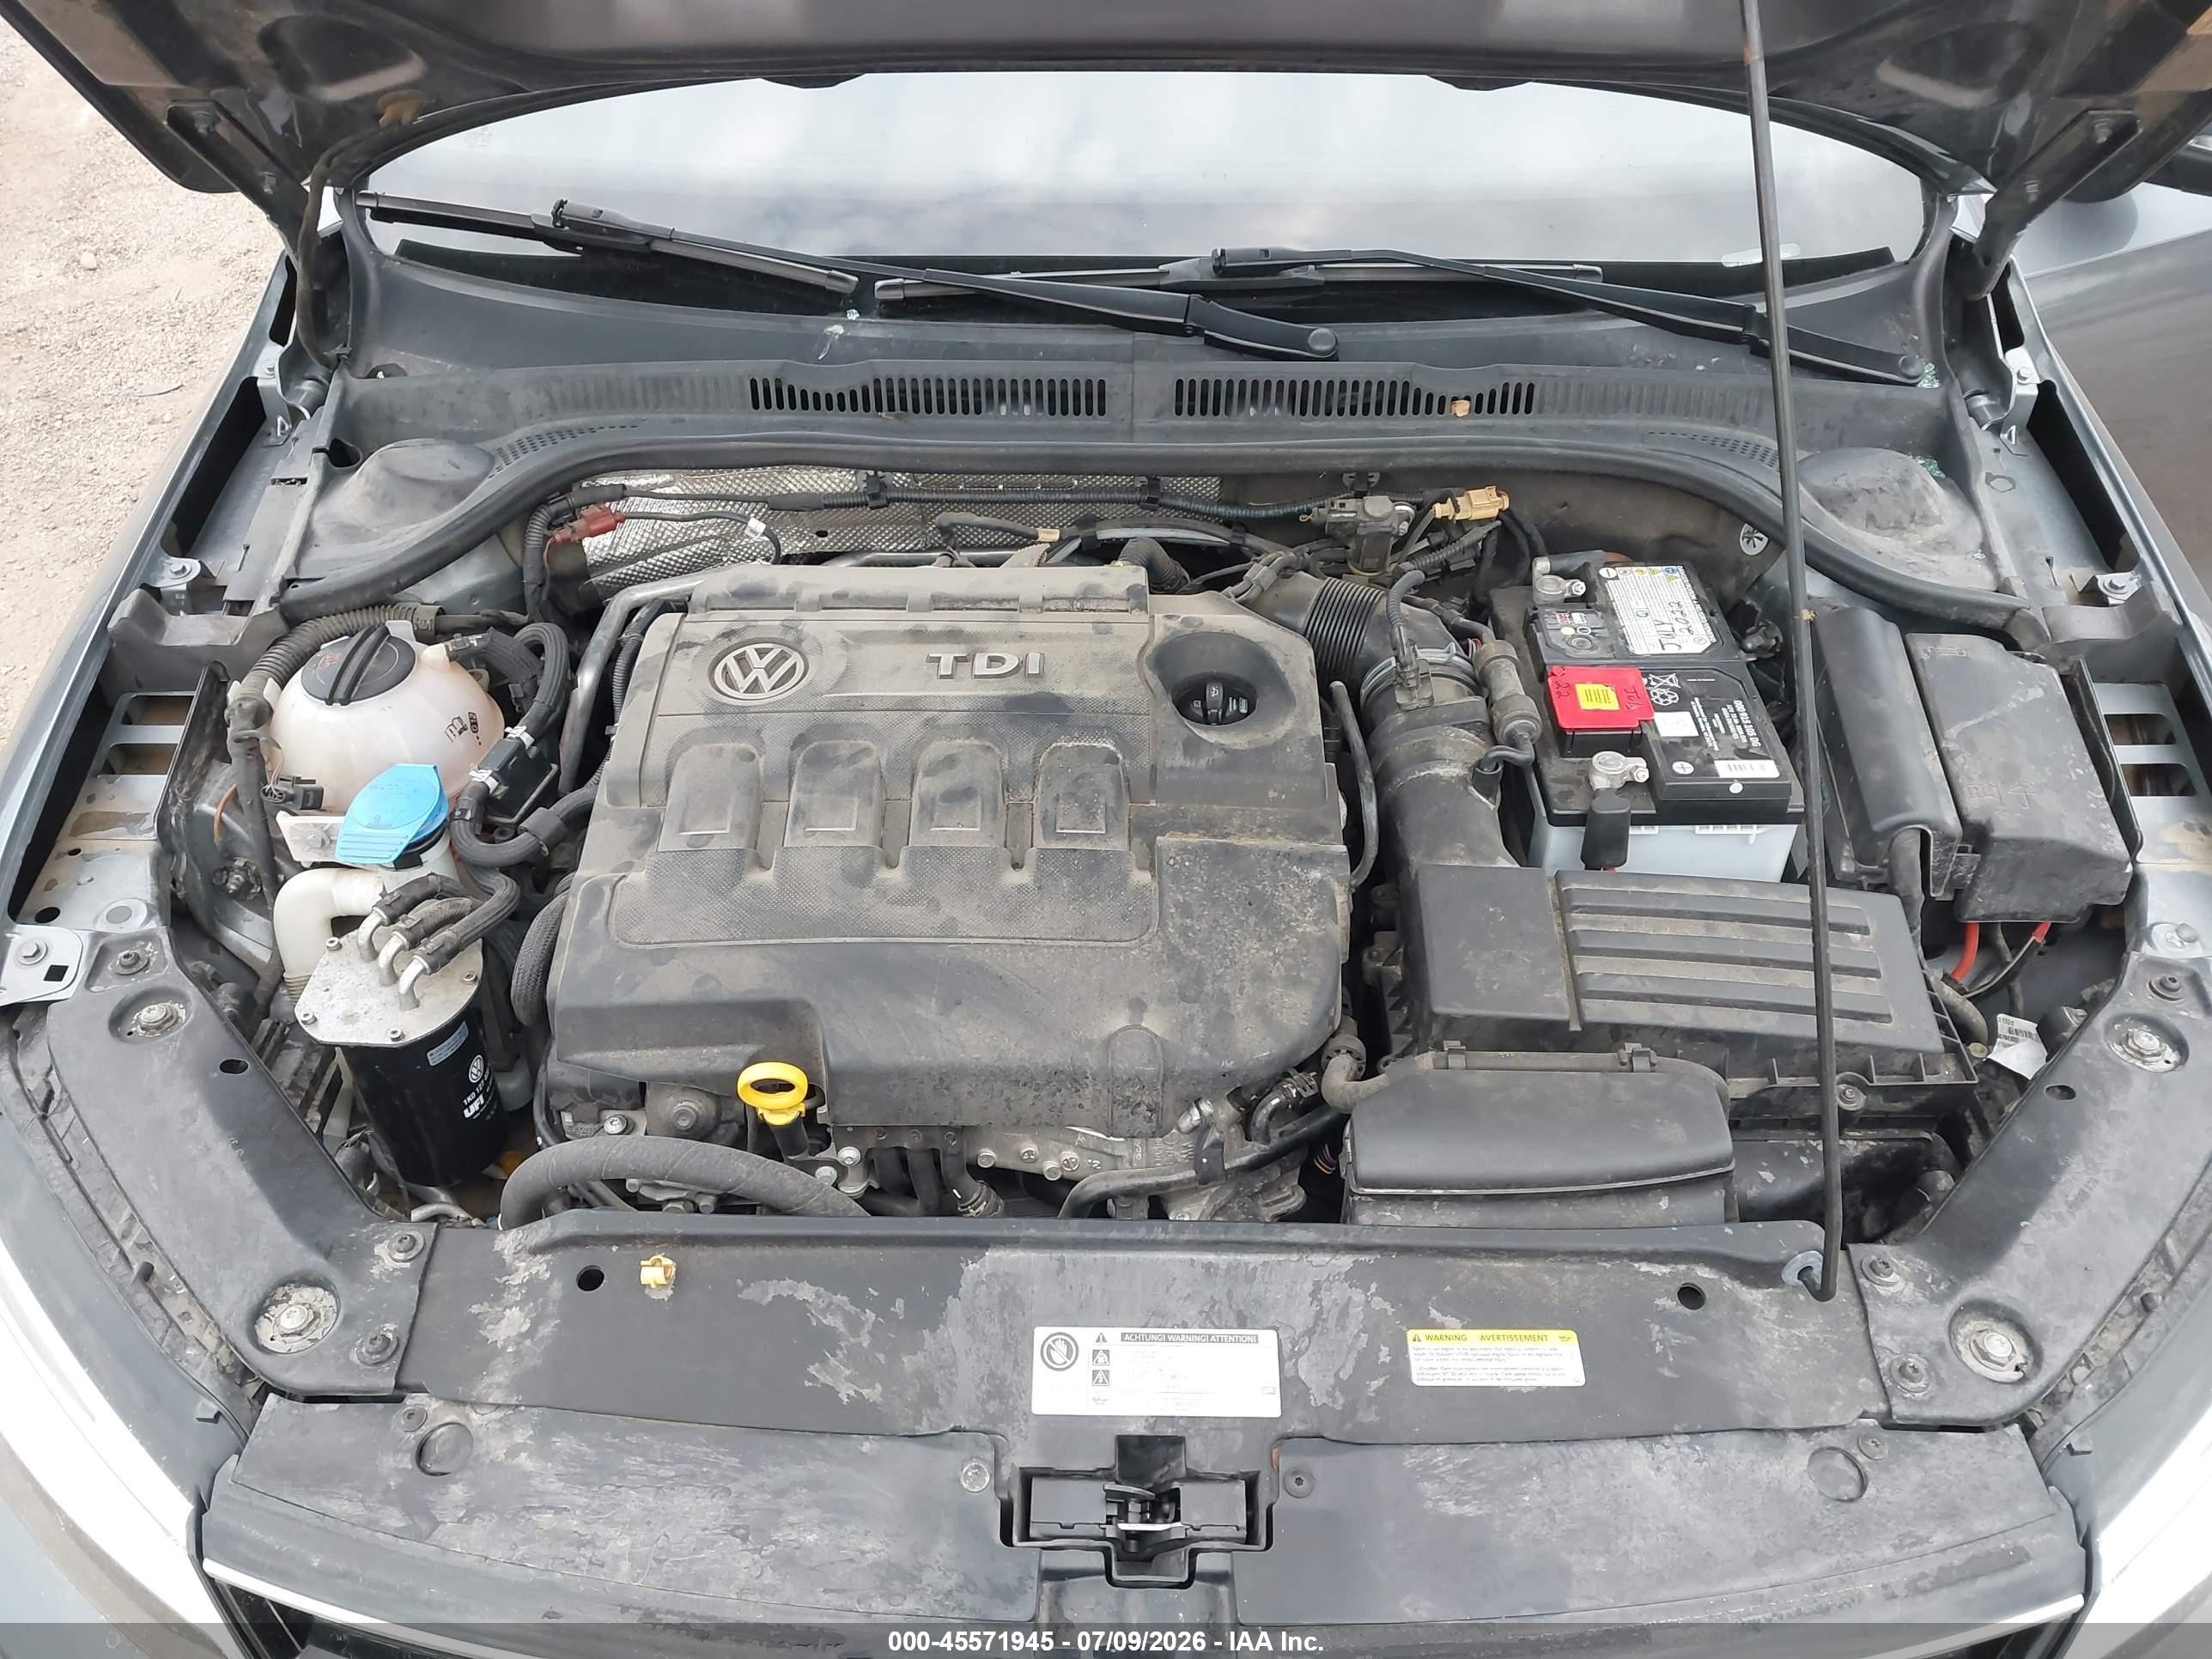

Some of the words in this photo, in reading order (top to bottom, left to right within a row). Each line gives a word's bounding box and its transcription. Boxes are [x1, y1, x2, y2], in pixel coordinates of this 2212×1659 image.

[1668, 601, 1693, 635] 2022
[1654, 619, 1681, 651] JULY
[714, 642, 805, 700] VW
[927, 652, 1045, 679] TDI
[1740, 712, 1752, 724] 915
[1744, 724, 1757, 737] 105
[1749, 737, 1761, 747] DG
[464, 1094, 484, 1118] UFI
[1124, 1334, 1166, 1342] ACHTUNG!
[1168, 1334, 1209, 1342] WARNING!
[1210, 1334, 1256, 1343] ATTENTION!
